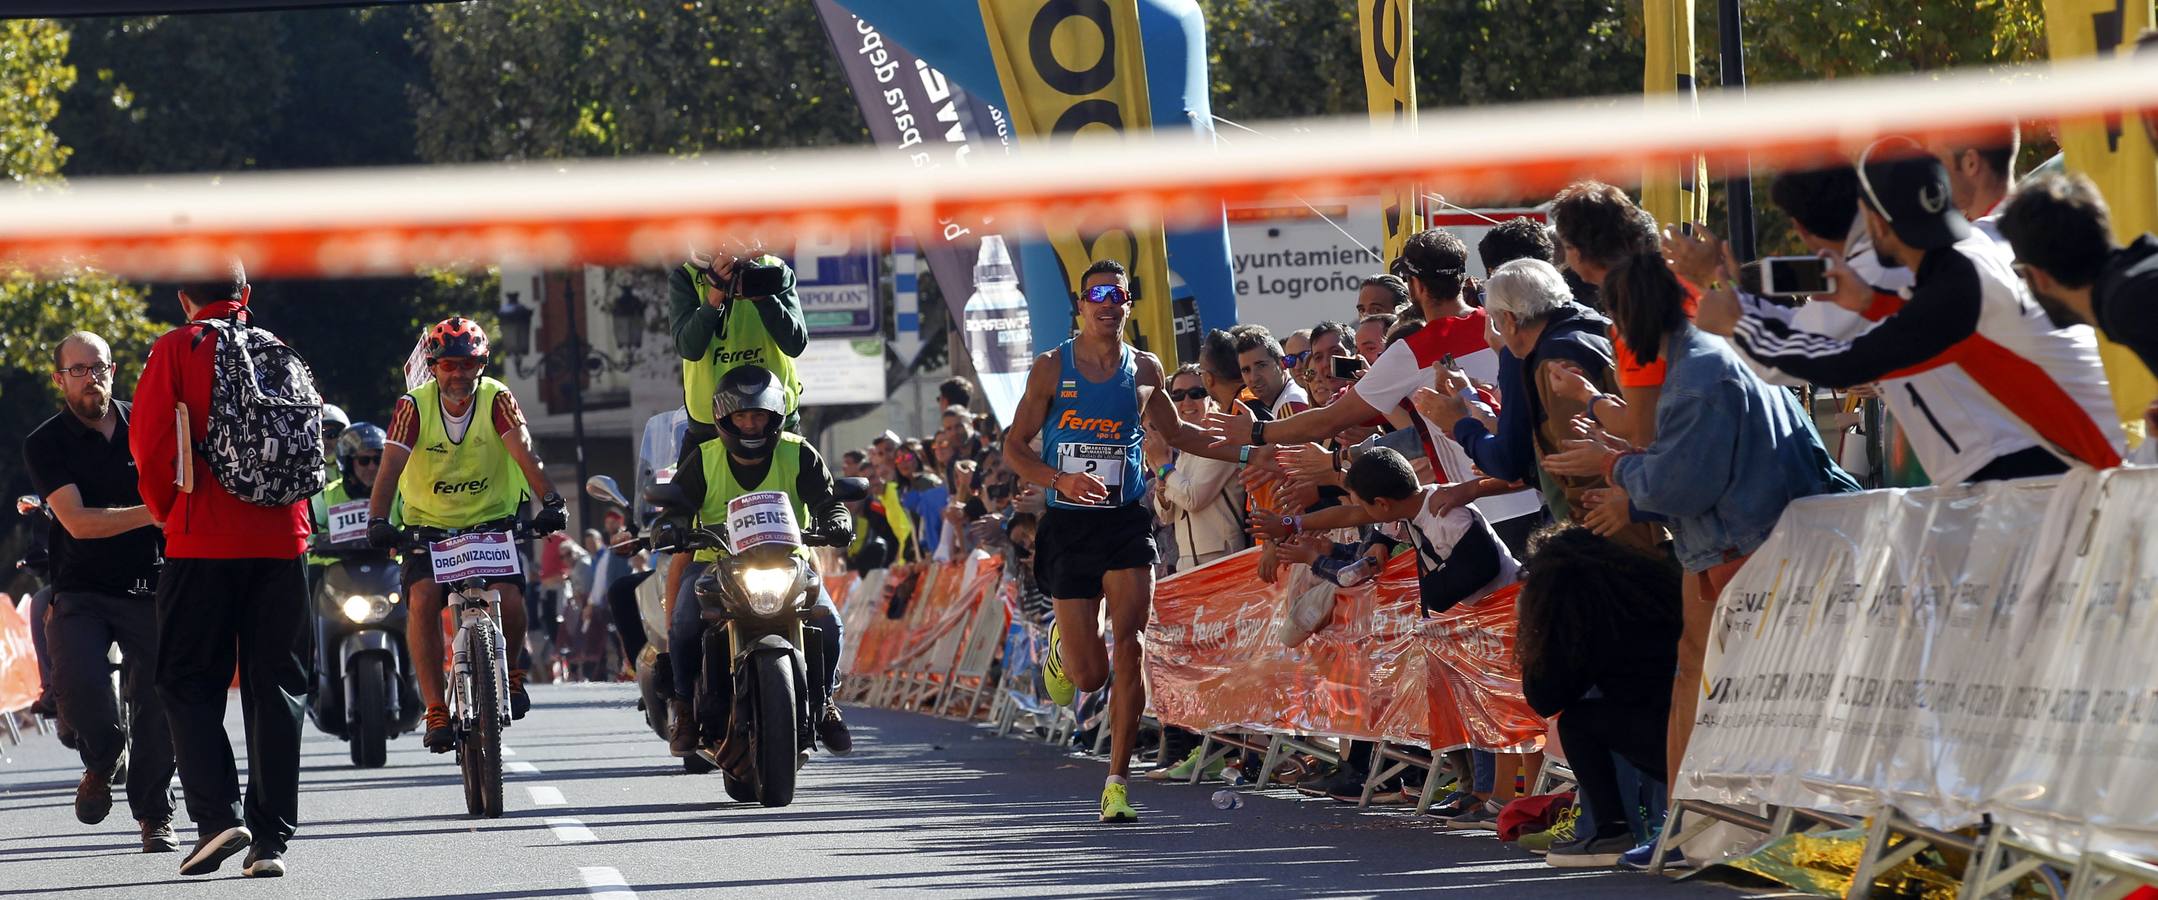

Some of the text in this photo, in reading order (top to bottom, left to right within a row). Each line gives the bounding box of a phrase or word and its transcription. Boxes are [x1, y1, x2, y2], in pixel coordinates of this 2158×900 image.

[1232, 245, 1384, 274] yuntamient
[1257, 271, 1360, 299] Logroño
[713, 346, 762, 366] Ferrer
[1057, 409, 1123, 433] Ferrer
[1085, 459, 1098, 473] 2
[433, 476, 488, 494] Ferrer
[336, 511, 369, 529] JUE
[732, 511, 790, 532] PRENS
[446, 533, 480, 547] MARATÓN
[434, 548, 511, 569] ORGANIZACIÓN
